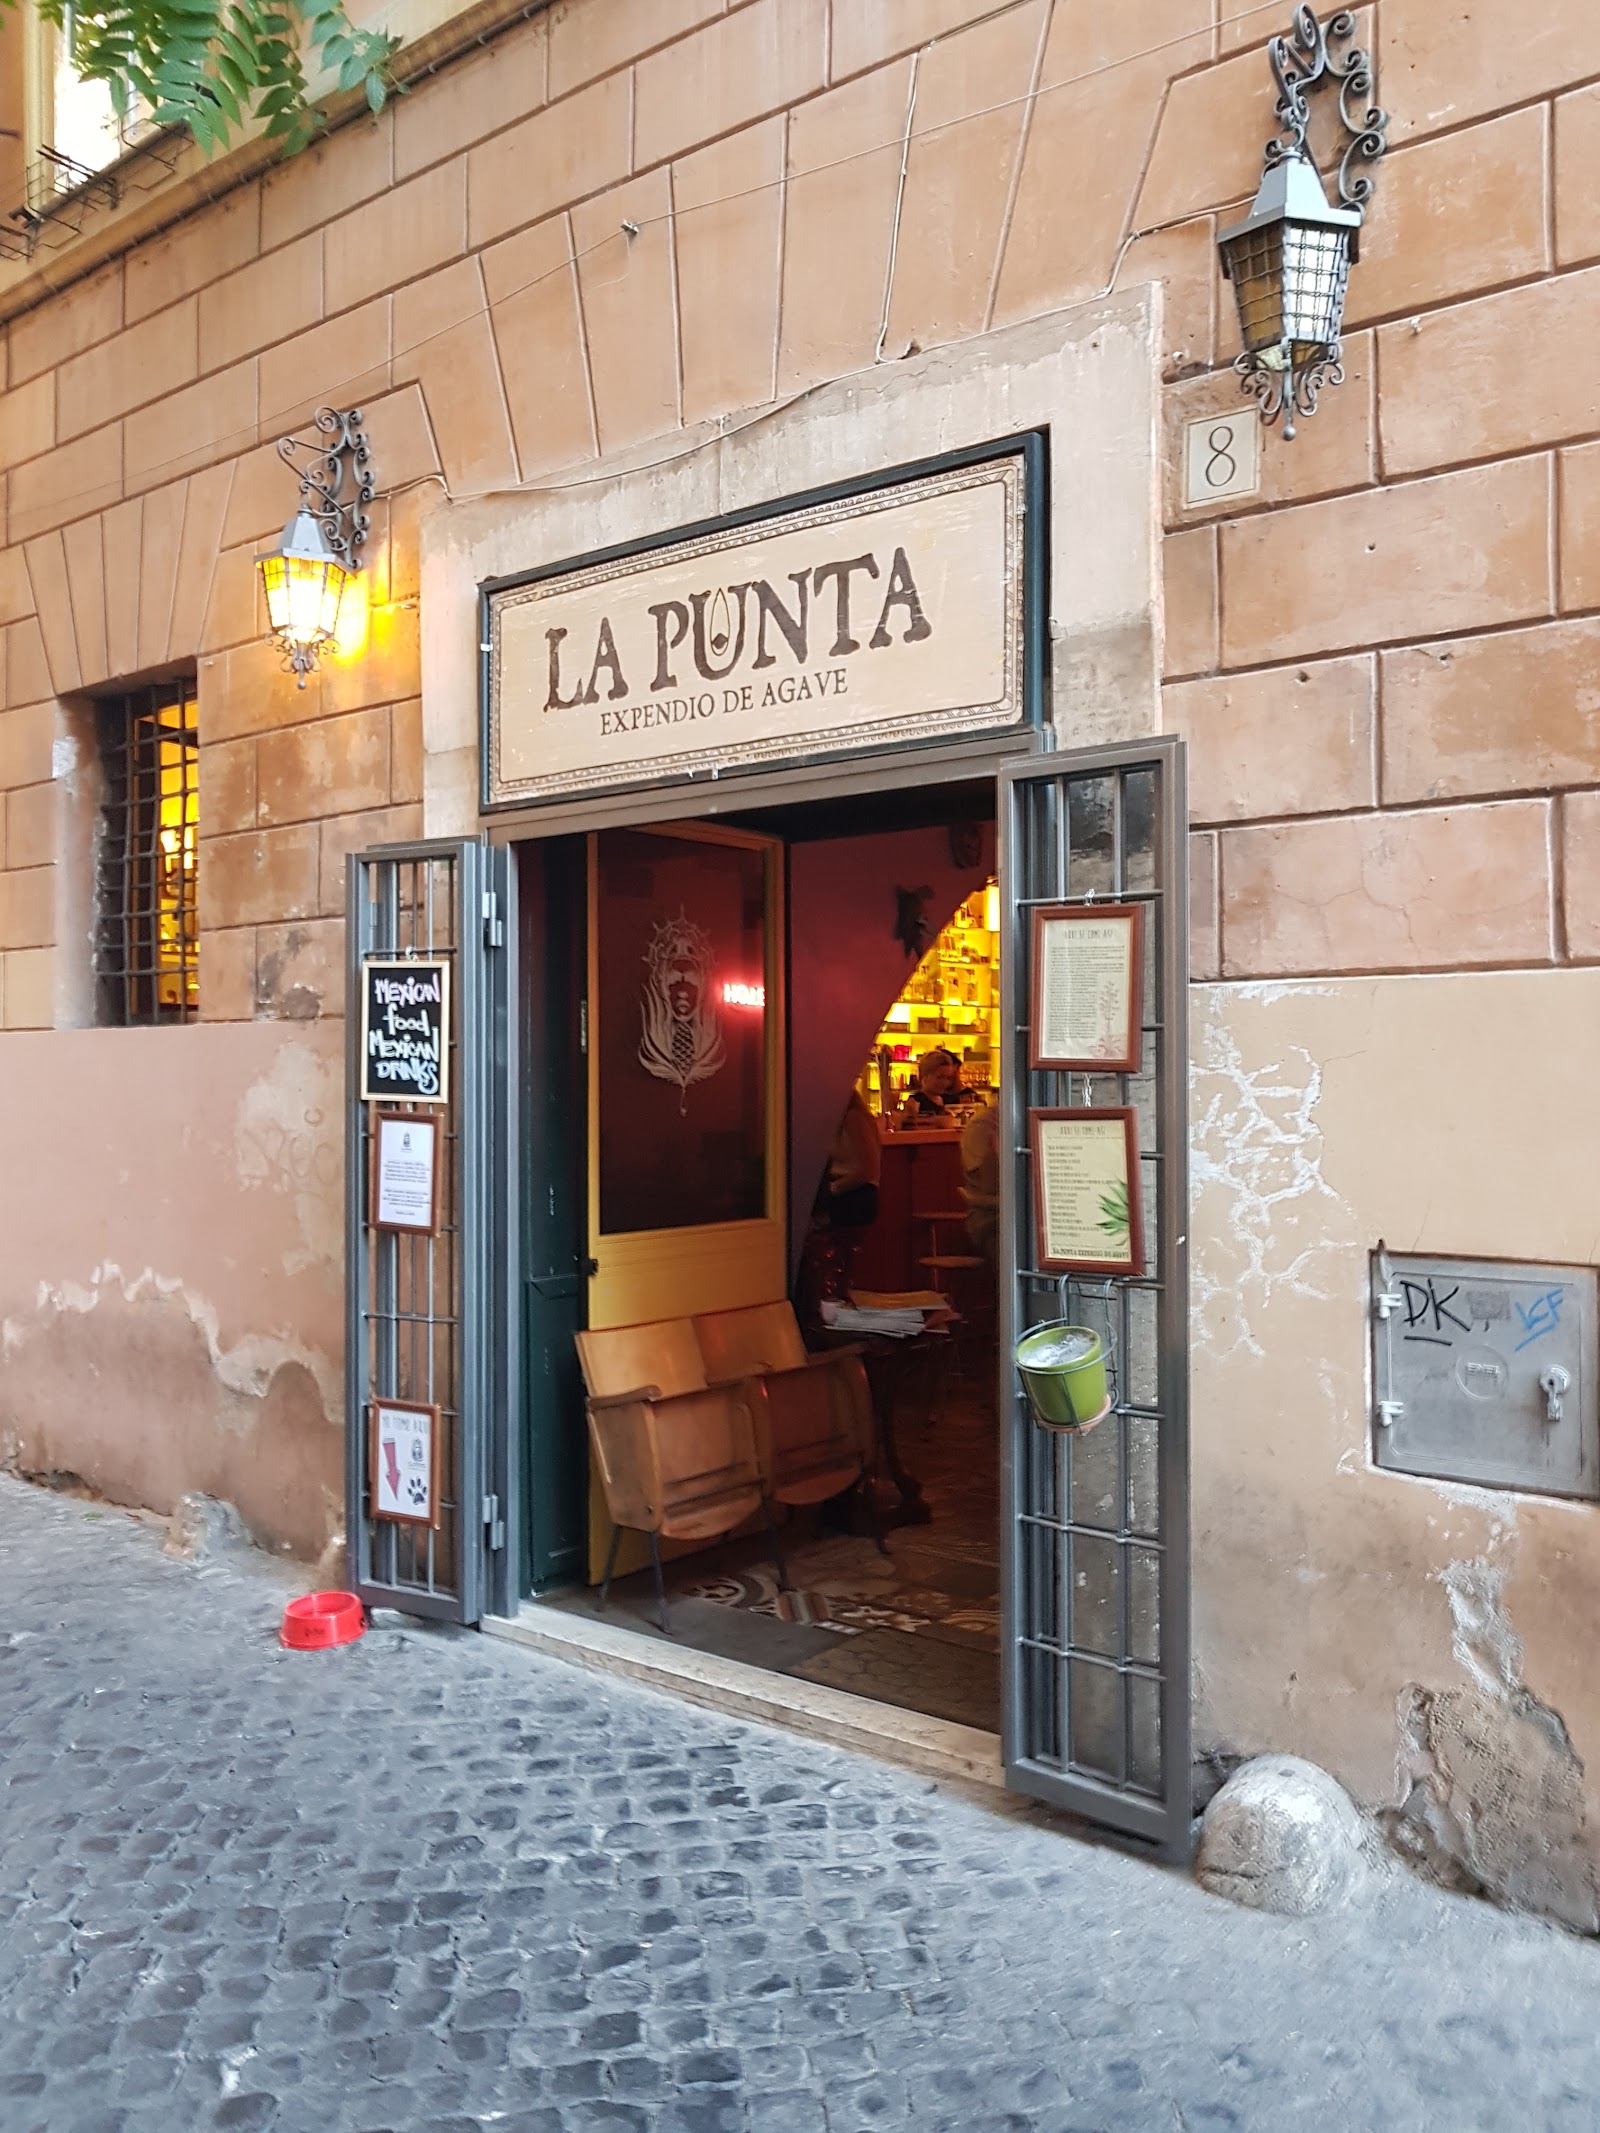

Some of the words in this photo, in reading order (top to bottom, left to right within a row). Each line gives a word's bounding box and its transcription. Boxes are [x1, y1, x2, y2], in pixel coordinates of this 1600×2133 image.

[1205, 425, 1236, 487] 8
[543, 616, 629, 713] LA
[647, 546, 933, 692] PUNTA
[600, 691, 715, 737] EXPENDIO
[723, 686, 754, 714] DE
[762, 667, 848, 709] AGAVE
[382, 1002, 430, 1037] food
